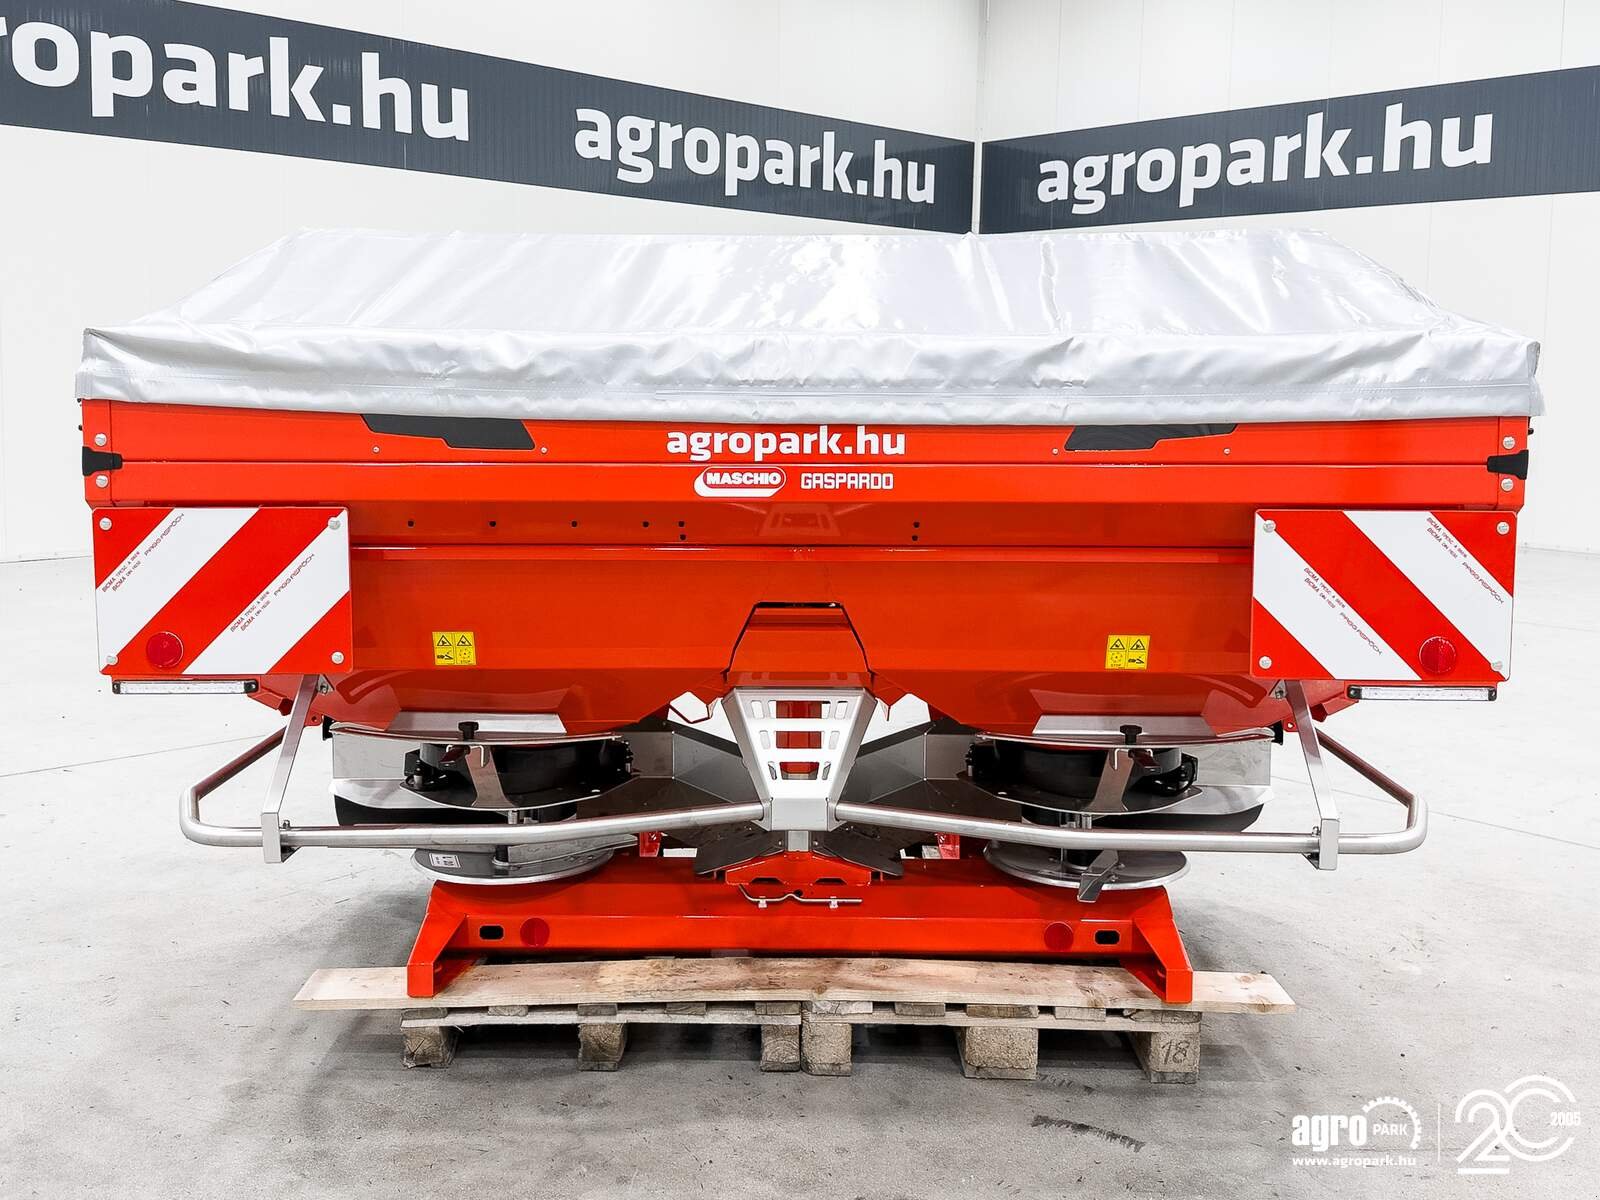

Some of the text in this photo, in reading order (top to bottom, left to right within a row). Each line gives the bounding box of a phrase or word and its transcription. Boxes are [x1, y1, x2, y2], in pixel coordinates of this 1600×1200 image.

[574, 108, 936, 204] agropark.hu
[1036, 102, 1494, 215] agropark.hu
[666, 425, 906, 462] agropark.hu
[706, 472, 894, 489] MASCHIO GASPARDO
[1161, 1039, 1191, 1065] 18
